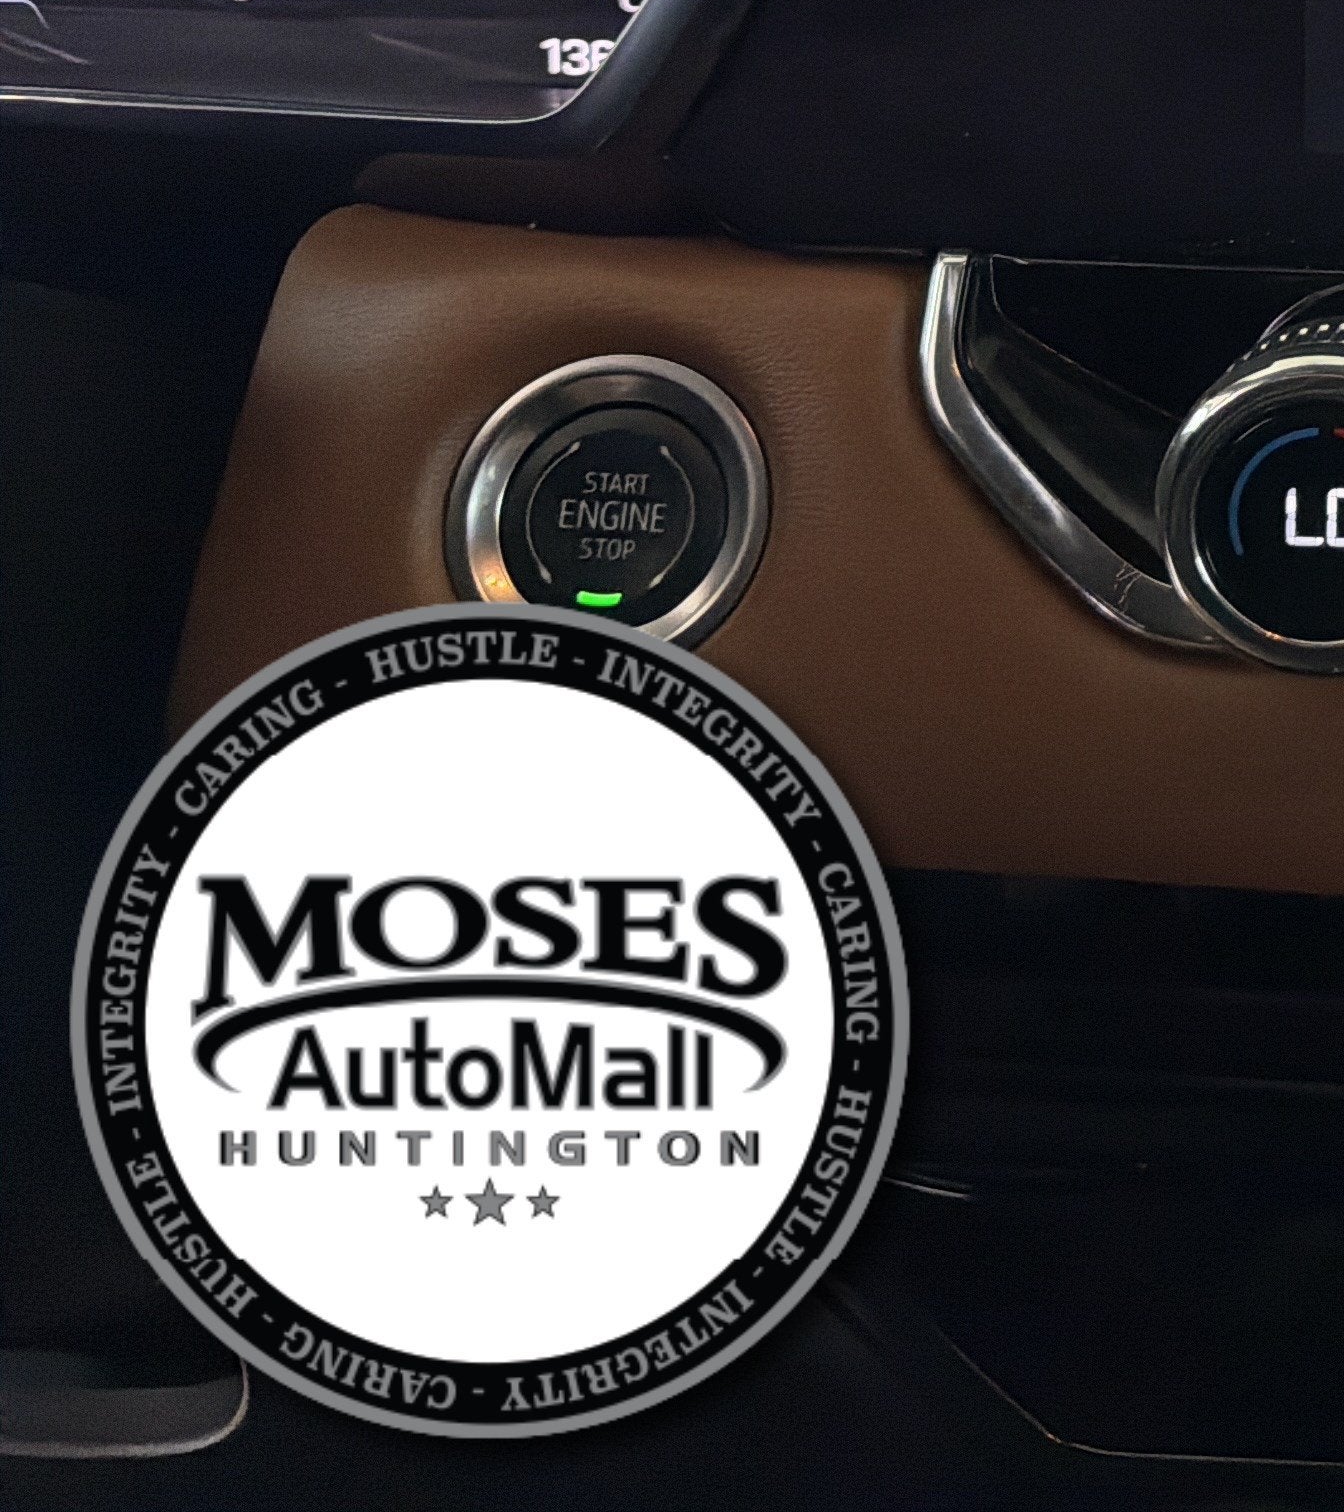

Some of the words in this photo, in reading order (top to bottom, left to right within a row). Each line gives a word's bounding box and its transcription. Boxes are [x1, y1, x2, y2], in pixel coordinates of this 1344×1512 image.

[584, 471, 650, 494] START
[558, 499, 668, 534] ENGINE
[578, 536, 637, 561] STOP
